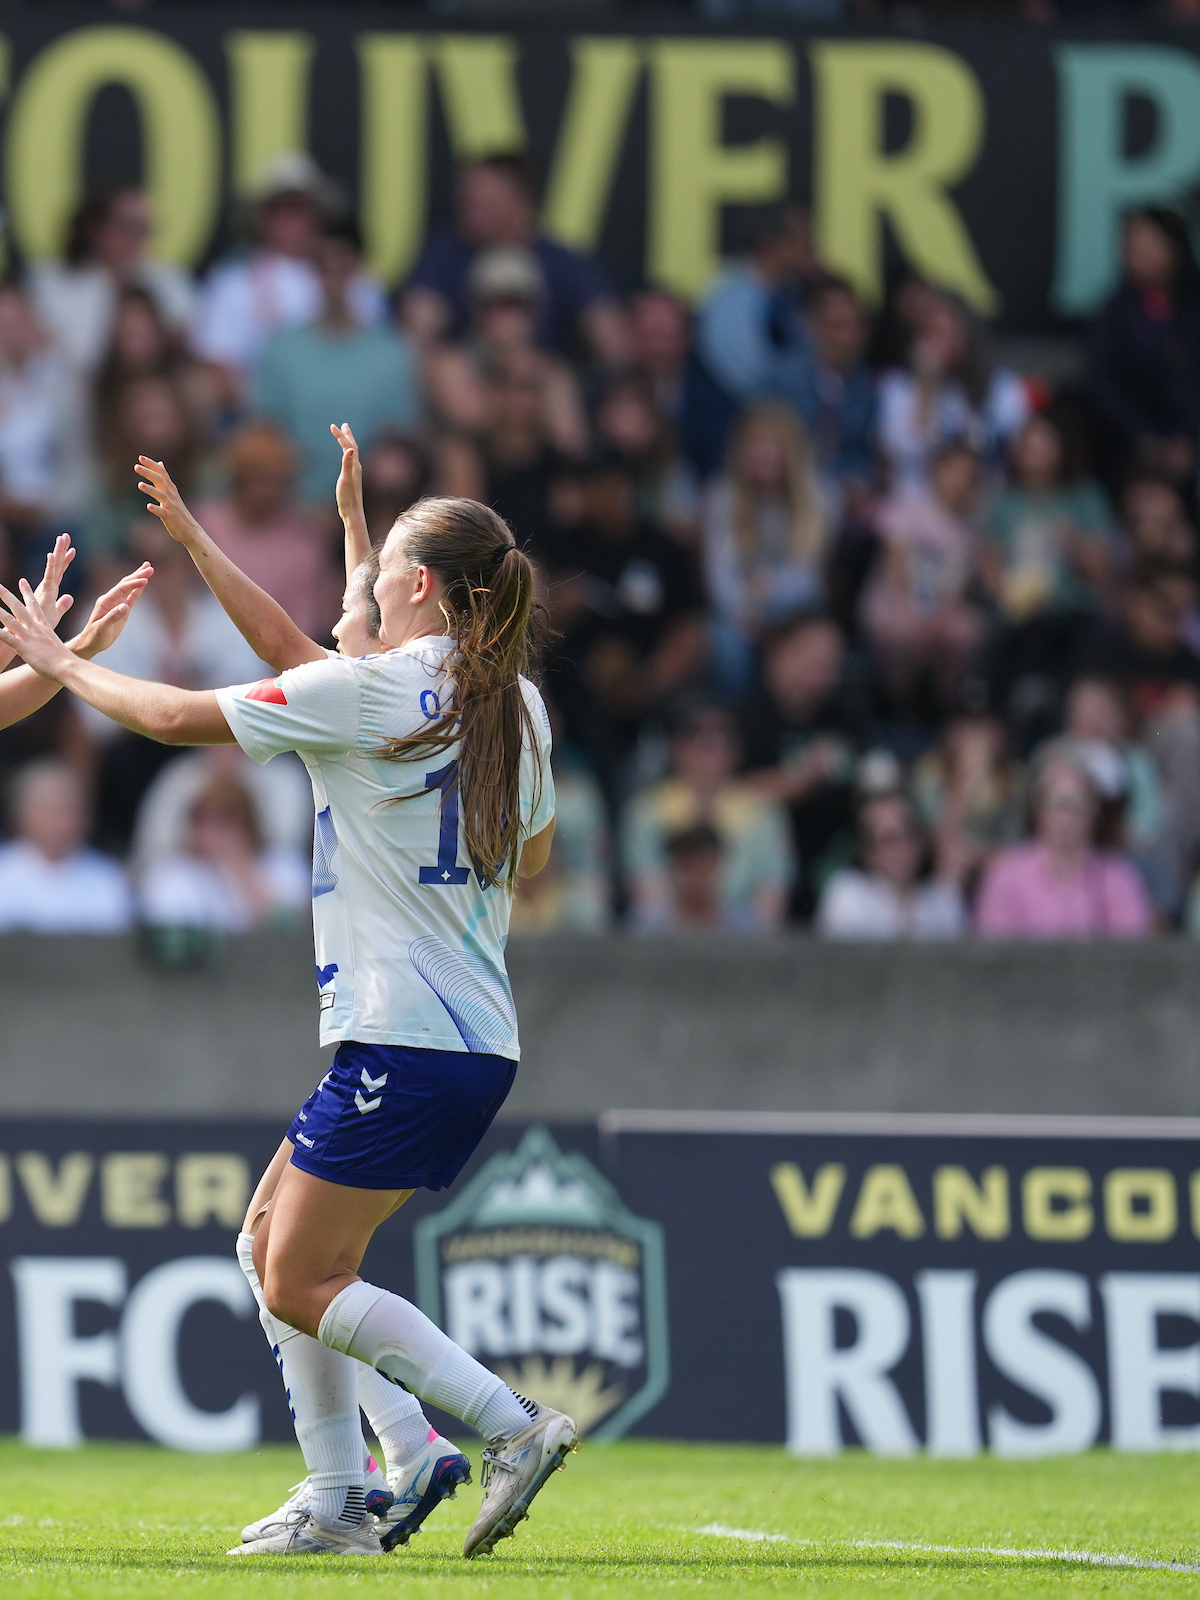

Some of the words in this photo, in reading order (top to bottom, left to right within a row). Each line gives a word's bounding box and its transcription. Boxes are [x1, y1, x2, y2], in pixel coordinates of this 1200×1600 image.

[770, 1162, 1200, 1242] VANCO
[11, 1256, 260, 1453] FC
[443, 1252, 644, 1367] RISE
